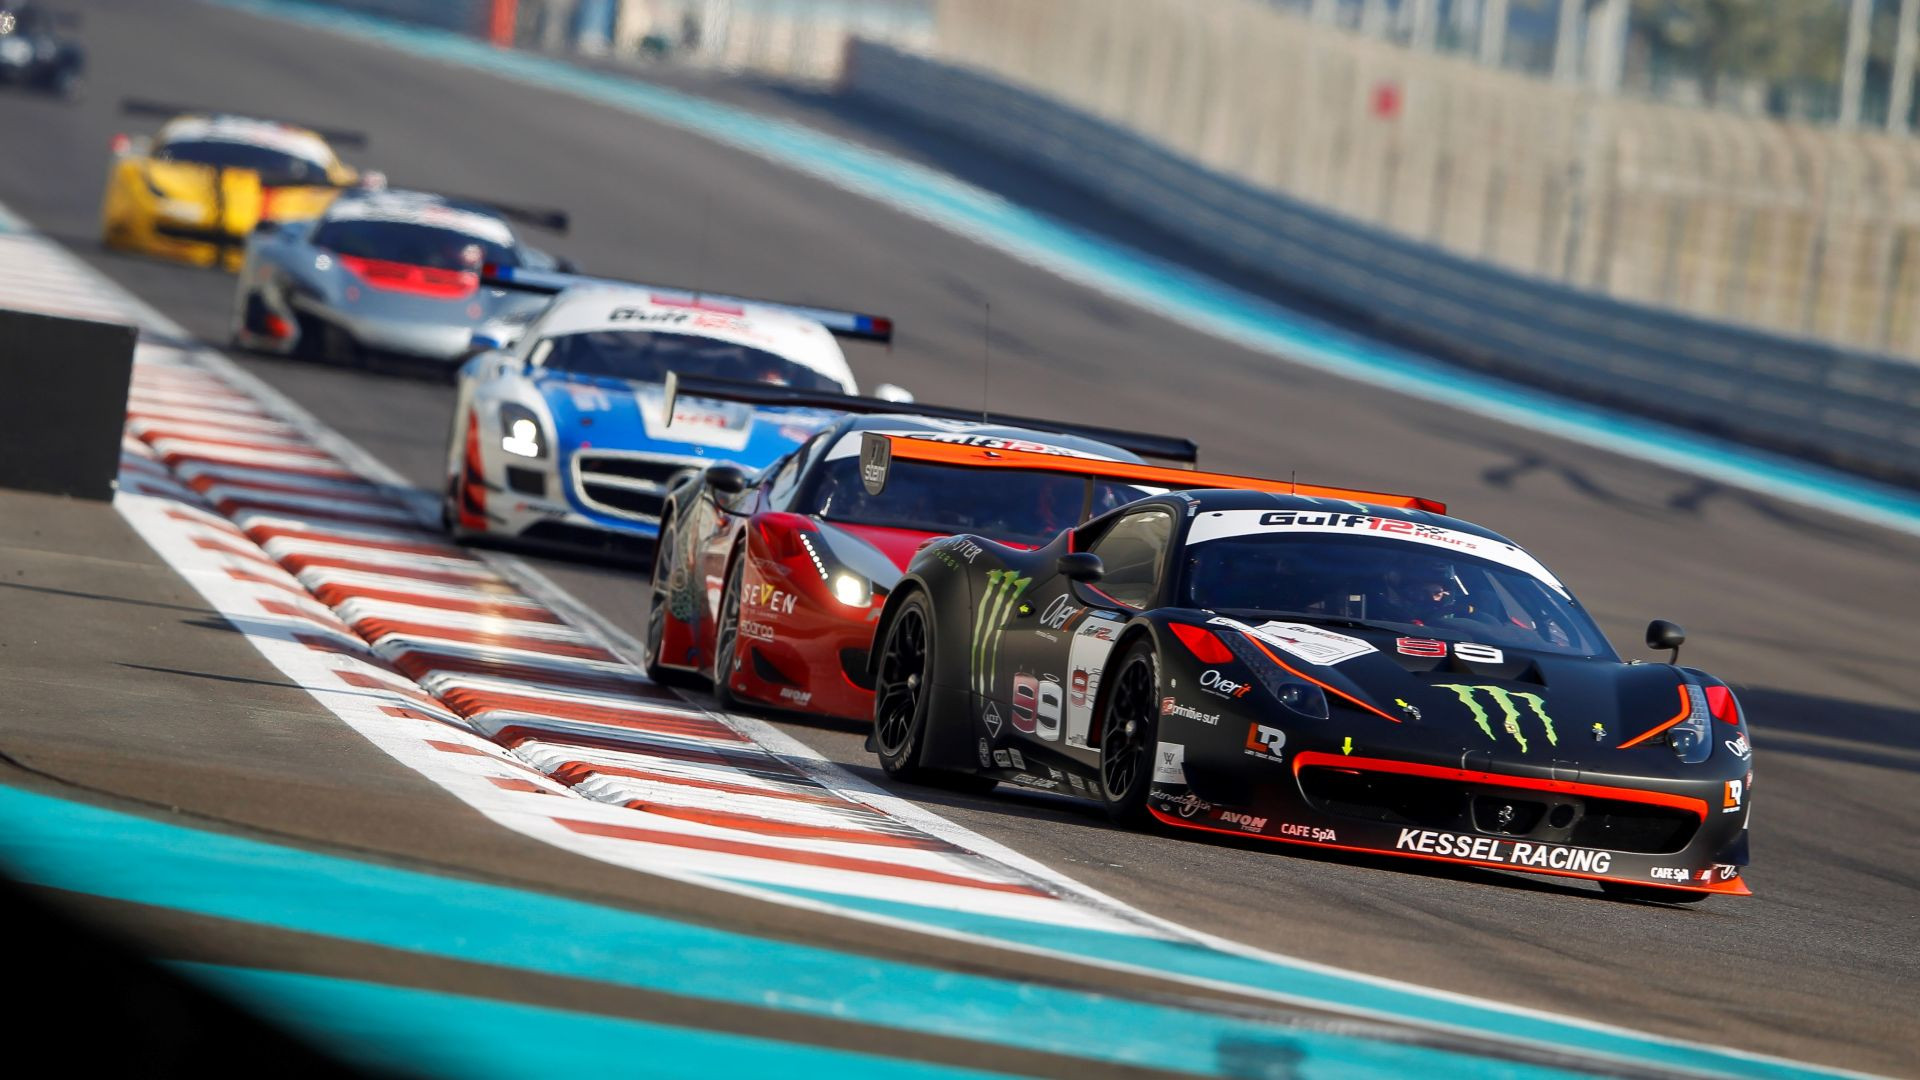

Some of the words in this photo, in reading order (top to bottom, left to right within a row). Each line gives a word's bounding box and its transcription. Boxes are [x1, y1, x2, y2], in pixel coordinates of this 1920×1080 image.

[1413, 530, 1478, 550] Hours
[742, 583, 798, 614] SEVEN
[1200, 669, 1252, 698] Overit
[1171, 703, 1203, 721] primitive
[1201, 713, 1221, 726] surf
[1220, 811, 1268, 828] AVON
[1281, 823, 1310, 837] CAFE
[1397, 829, 1503, 862] KESSEL
[1510, 843, 1611, 873] RACING
[1651, 867, 1673, 879] CAFE
